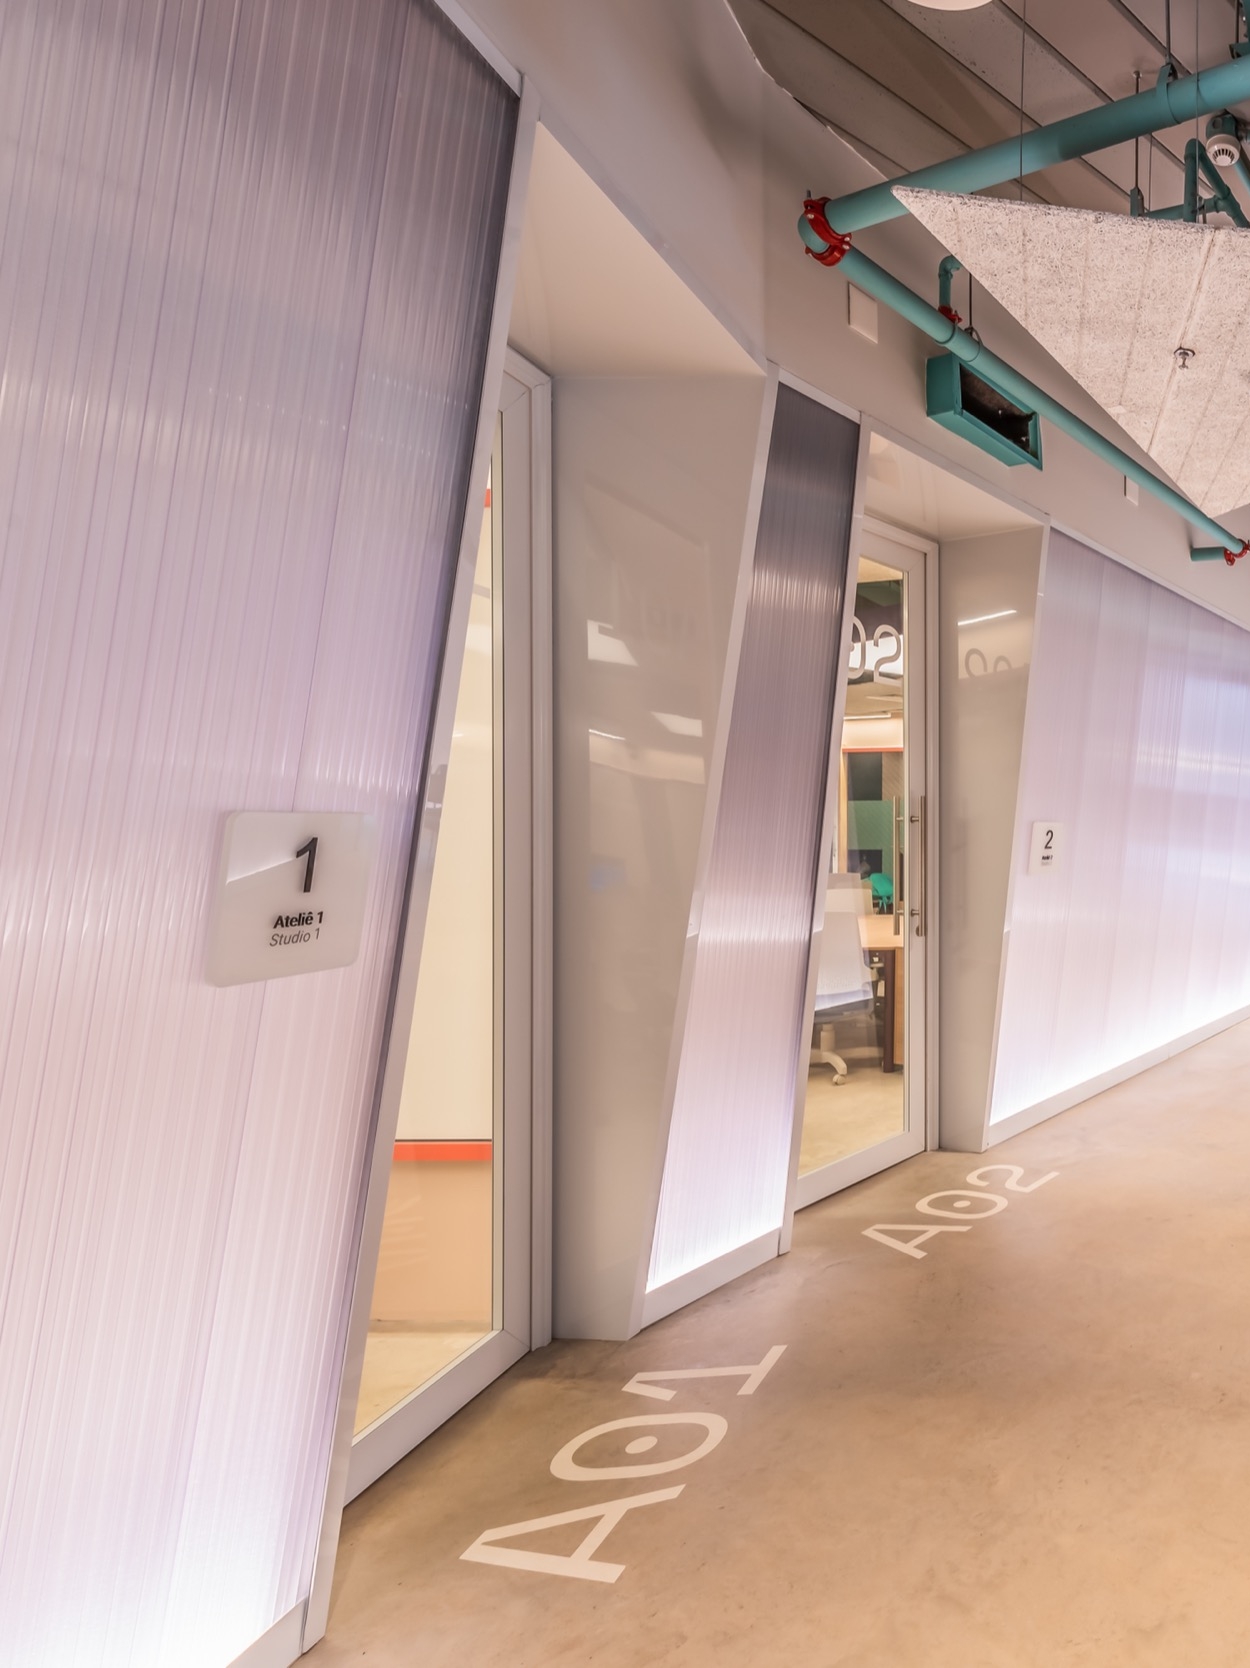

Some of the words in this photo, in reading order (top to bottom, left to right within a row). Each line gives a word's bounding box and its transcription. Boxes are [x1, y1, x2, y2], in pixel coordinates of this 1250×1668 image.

[1044, 829, 1054, 850] 2
[296, 837, 318, 893] 1
[269, 931, 311, 947] Studio
[315, 928, 320, 940] 1
[273, 911, 314, 929] Ateliê
[317, 911, 324, 924] 1
[861, 1163, 1059, 1260] A02
[458, 1344, 788, 1585] A01
